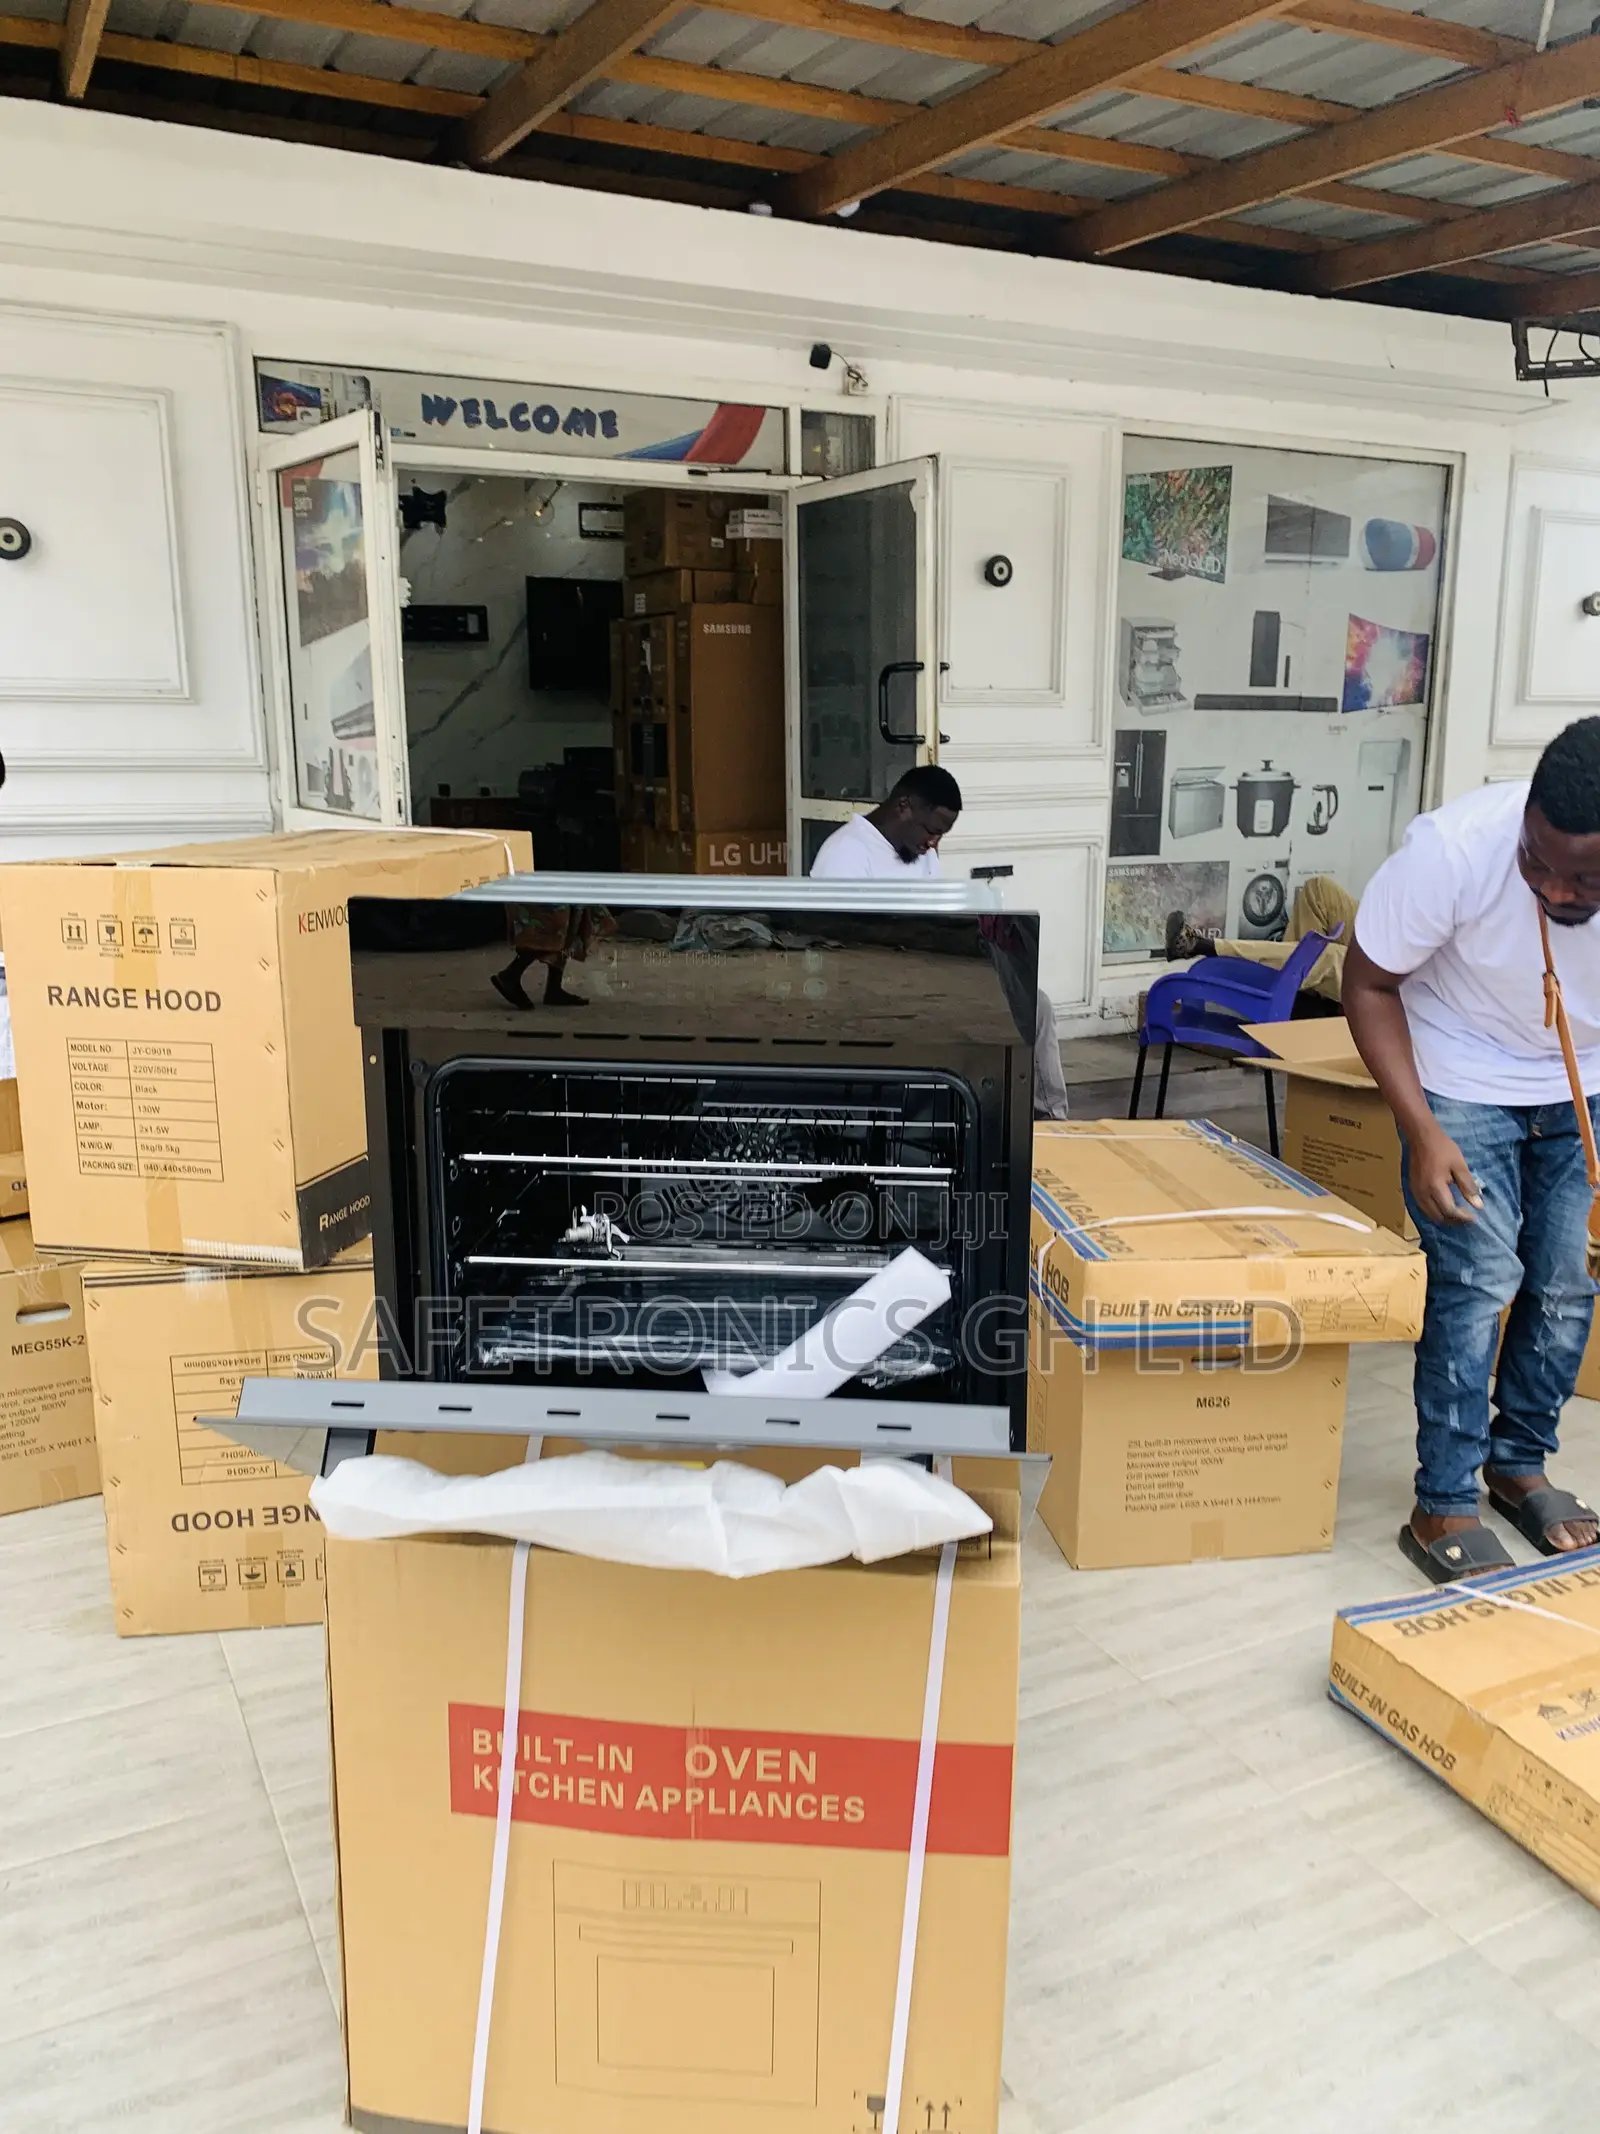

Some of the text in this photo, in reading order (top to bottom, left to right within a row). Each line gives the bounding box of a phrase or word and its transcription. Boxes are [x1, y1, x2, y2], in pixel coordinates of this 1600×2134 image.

[420, 393, 620, 438] WELCOME
[703, 623, 751, 635] SAMSUNG
[709, 843, 741, 867] LG
[298, 904, 349, 935] KENWOO
[46, 985, 222, 1013] RANGE HOOD
[70, 1043, 96, 1053] MODEL
[133, 1065, 178, 1076] 220V/50Hz
[135, 1084, 158, 1094] Black
[76, 1101, 108, 1111] Motor:
[137, 1105, 161, 1114] 130W
[82, 1160, 116, 1170] PACKING
[318, 1195, 371, 1232] RANGE HOOD
[1044, 1263, 1070, 1303] HOB
[1176, 1302, 1212, 1317] GAS
[1216, 1301, 1255, 1317] HOB
[11, 1334, 85, 1356] MEG55K-2
[7, 1383, 54, 1398] microwave
[1196, 1396, 1231, 1409] M626
[171, 1504, 321, 1533] NGE HOOD
[1331, 1660, 1457, 1773] BUILT-IN GAS HOB
[685, 1744, 817, 1785] OVEN
[635, 1785, 866, 1823] APPLIANCES
